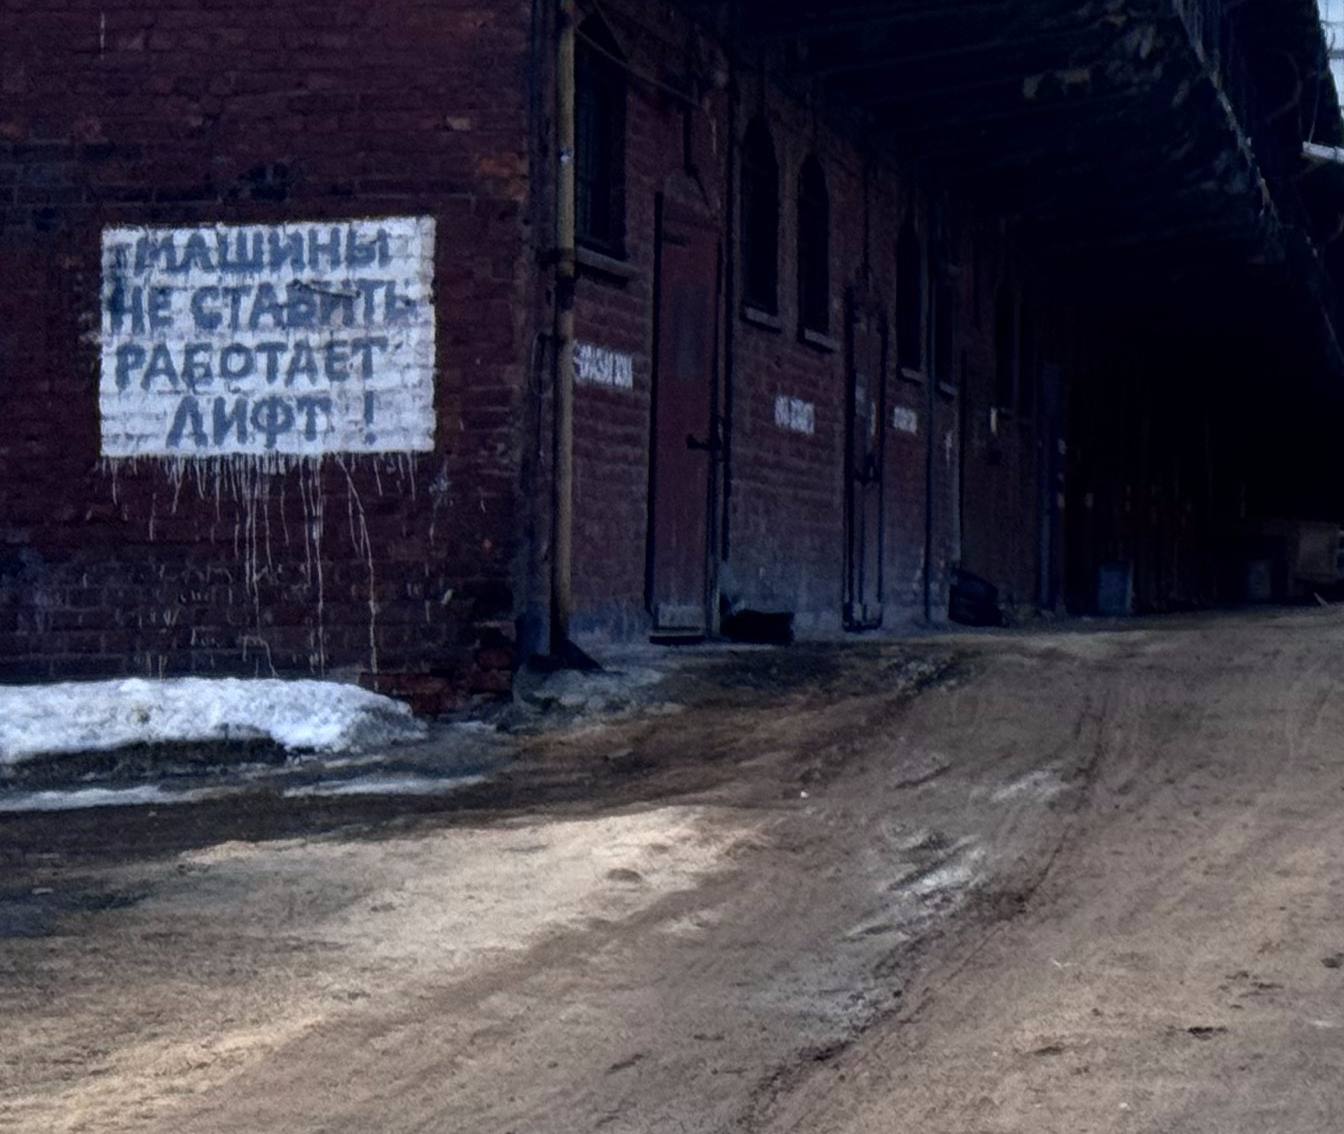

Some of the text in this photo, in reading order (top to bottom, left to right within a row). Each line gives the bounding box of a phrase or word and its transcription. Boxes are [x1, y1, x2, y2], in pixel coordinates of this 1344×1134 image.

[131, 227, 392, 278] МАШИНЫ
[110, 278, 416, 334] НЕ СТАВИТЬ
[114, 336, 389, 391] РАБОТАЕТ
